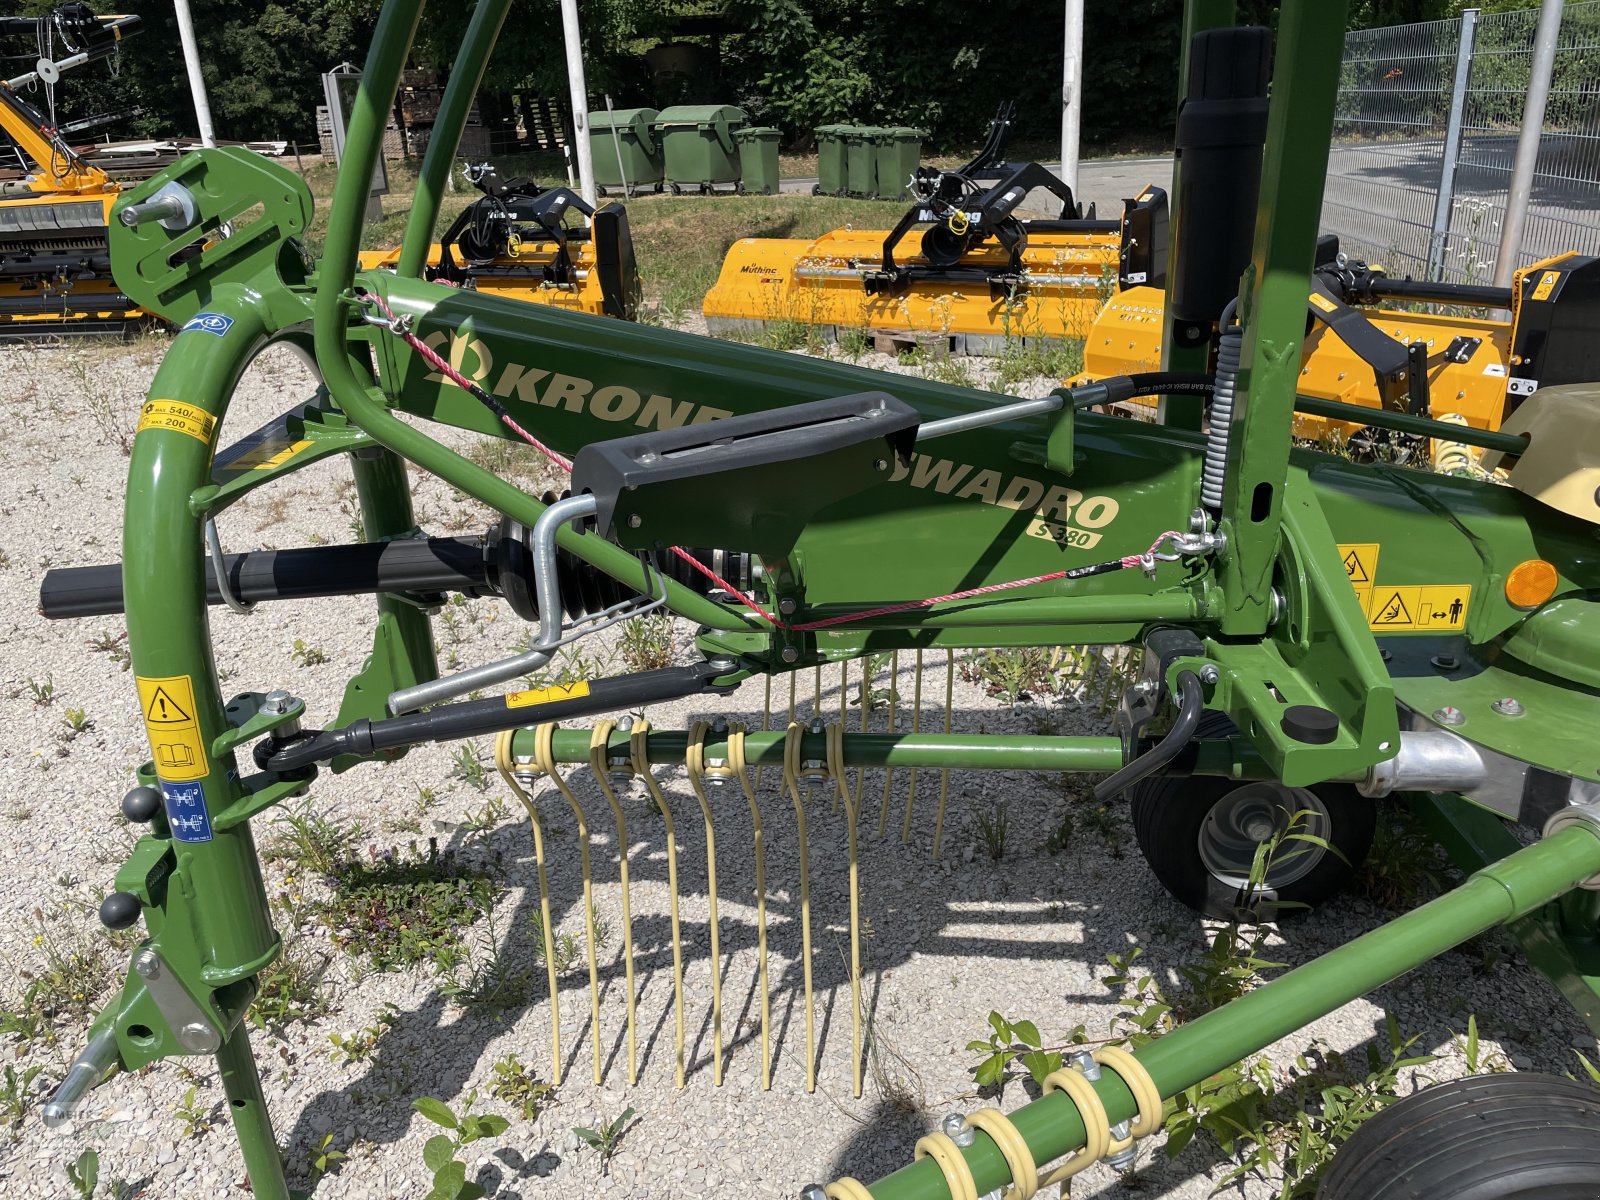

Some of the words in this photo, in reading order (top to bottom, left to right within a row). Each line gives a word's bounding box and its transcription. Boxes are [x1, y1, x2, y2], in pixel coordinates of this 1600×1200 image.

[165, 418, 186, 429] 200
[1035, 523, 1049, 537] S
[1052, 525, 1092, 547] 380
